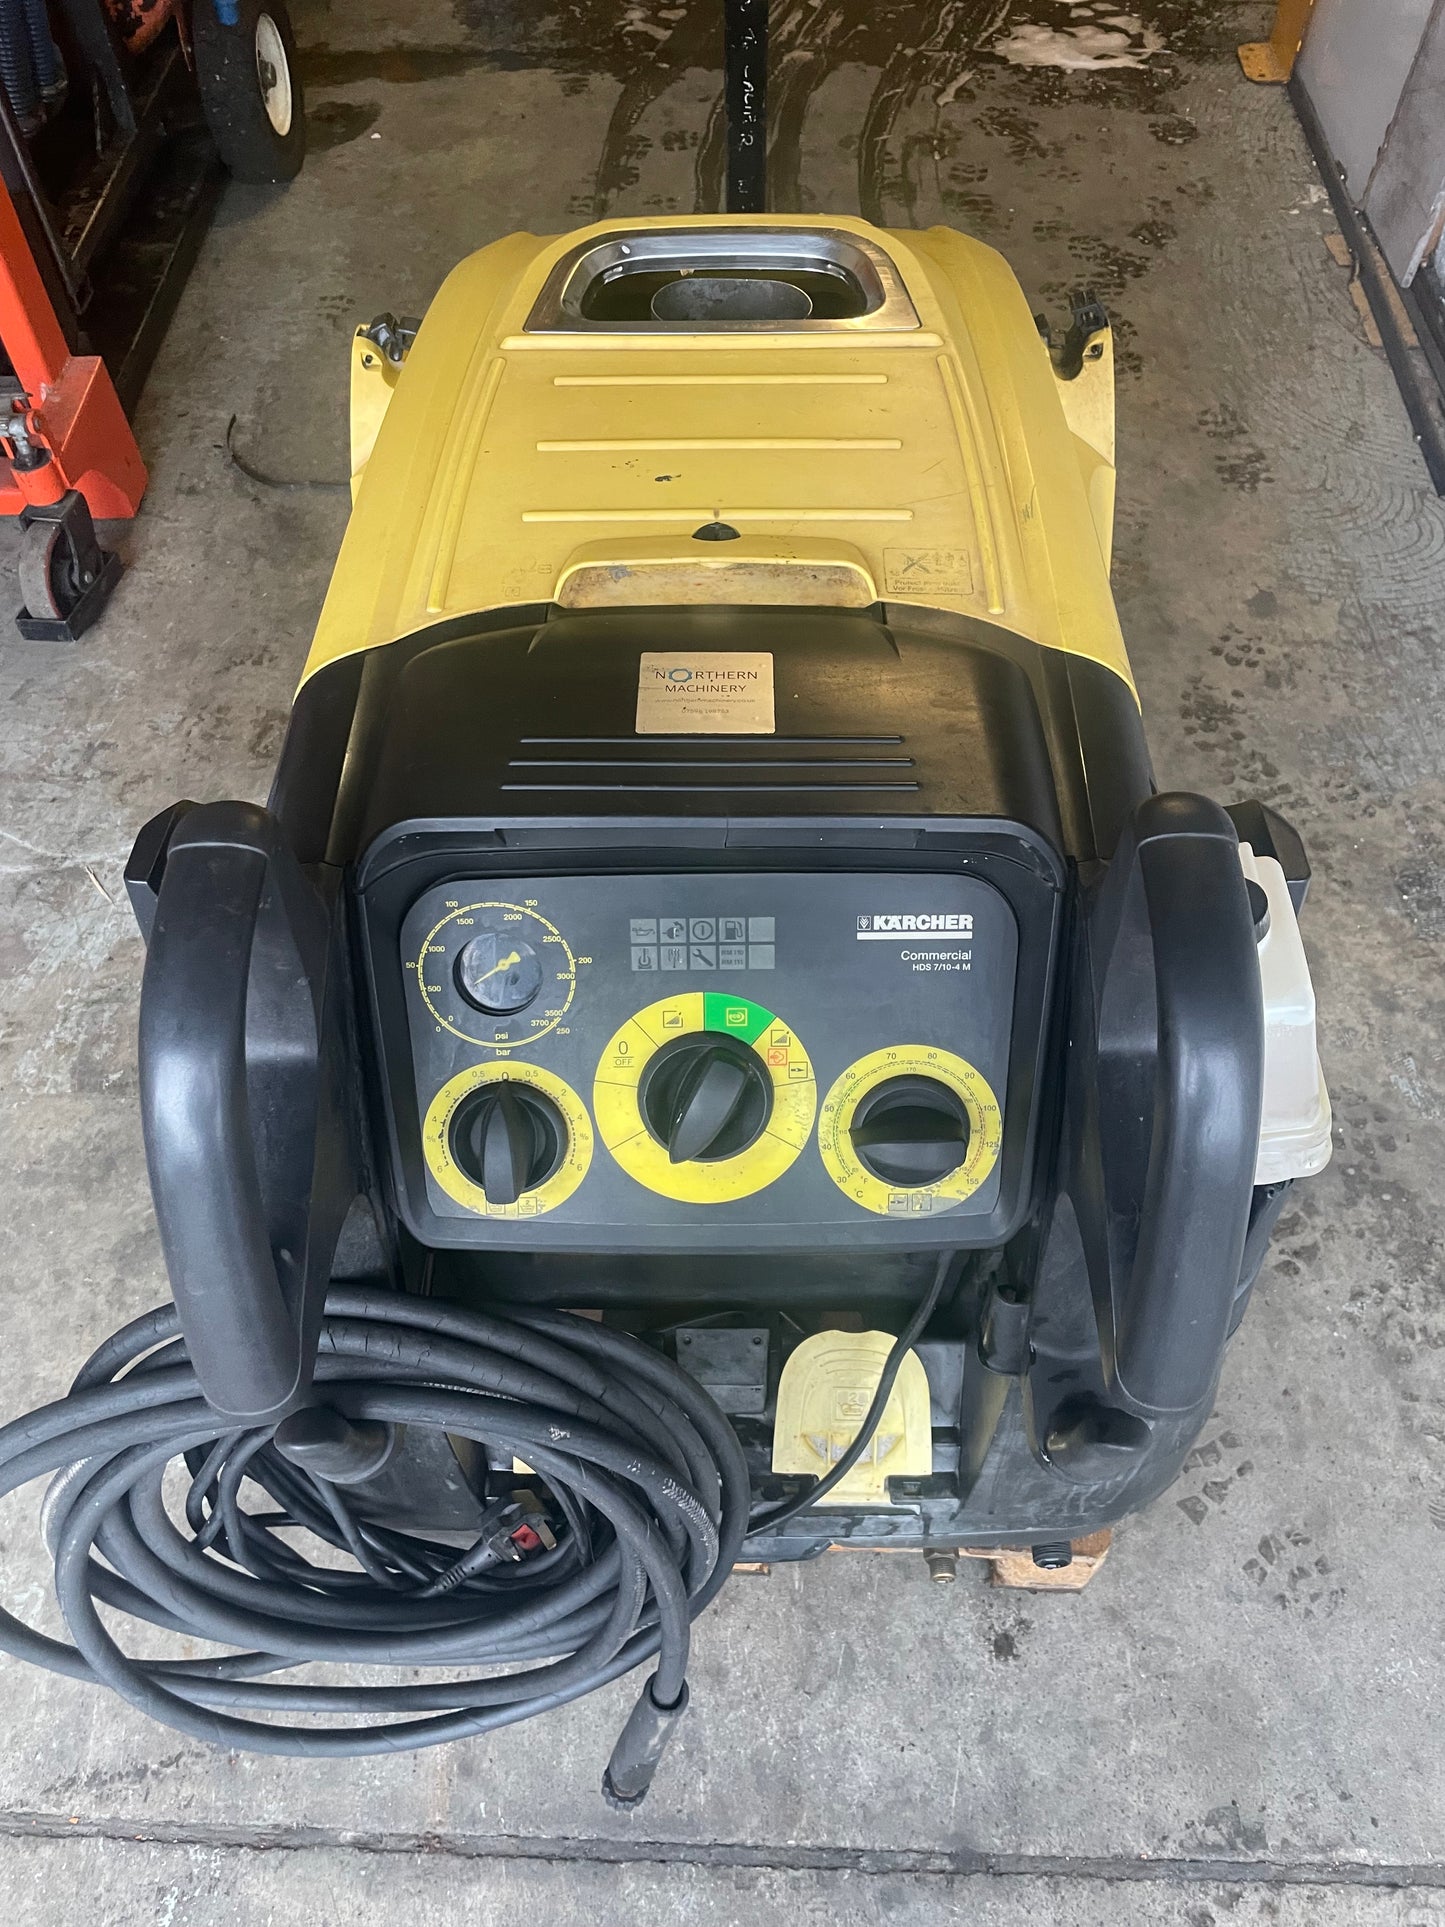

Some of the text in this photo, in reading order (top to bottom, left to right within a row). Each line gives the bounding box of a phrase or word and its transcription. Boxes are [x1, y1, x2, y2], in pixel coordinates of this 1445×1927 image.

[656, 668, 758, 682] NORTHERN
[665, 684, 746, 692] MACHINERY
[873, 914, 973, 930] KÄRCHER
[900, 950, 972, 960] Commercial
[912, 963, 932, 971] HDS
[934, 963, 960, 971] 7/10-4
[544, 1009, 564, 1017] 3500
[530, 1019, 550, 1027] 3700
[495, 1032, 509, 1041] psi
[496, 1048, 511, 1056] bar
[619, 1041, 628, 1055] 0
[502, 1072, 509, 1082] 0
[526, 1070, 538, 1078] 0,5
